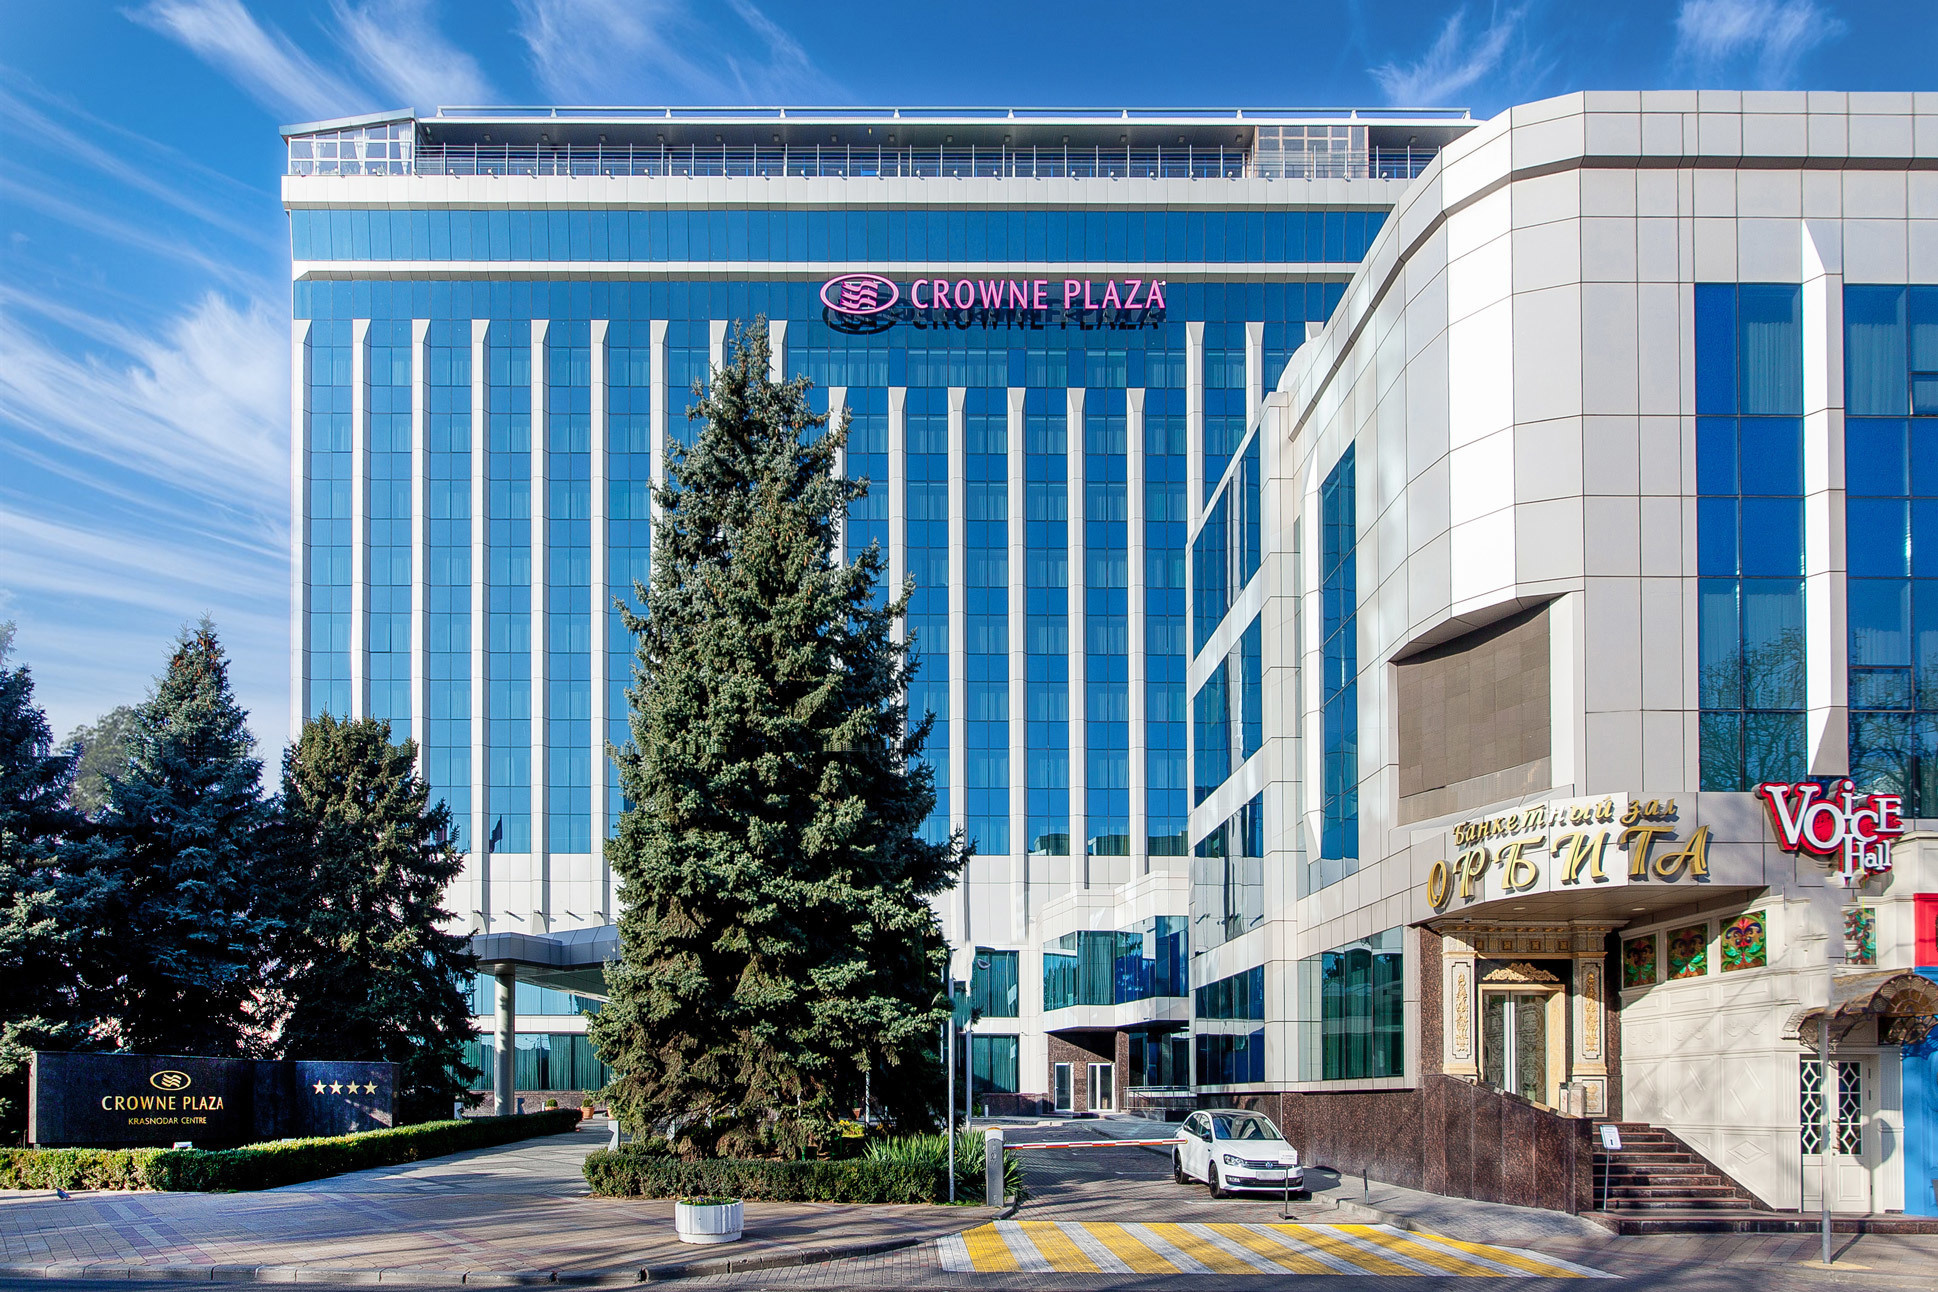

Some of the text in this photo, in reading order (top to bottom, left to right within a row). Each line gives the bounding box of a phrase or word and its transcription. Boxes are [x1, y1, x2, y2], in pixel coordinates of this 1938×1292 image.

[911, 279, 1166, 310] CROWNE PLAZA
[1453, 796, 1678, 846] Банкетный зал
[1427, 825, 1710, 908] ОРБИТА
[1842, 834, 1892, 878] Hall
[101, 1095, 224, 1111] CROWNE PLAZA
[128, 1116, 207, 1125] KRASNODAR CENTRE
